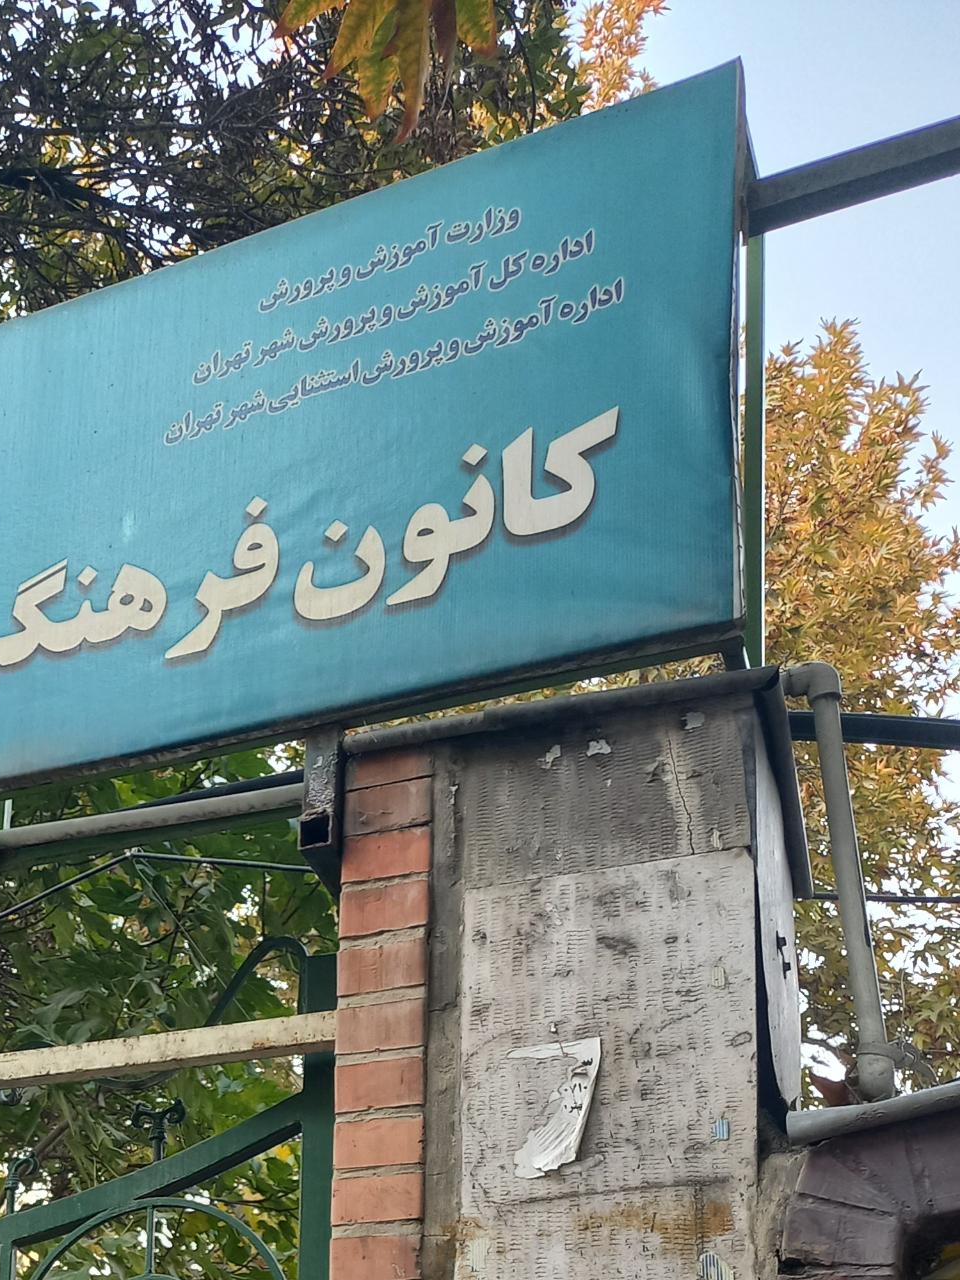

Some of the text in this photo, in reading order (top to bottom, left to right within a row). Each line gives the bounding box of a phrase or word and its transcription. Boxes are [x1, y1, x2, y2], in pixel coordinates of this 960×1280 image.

[193, 230, 595, 385] اداره کل آموزش و پرورش شهر تهران
[259, 207, 520, 312] وزارت آموزش و پرورش
[164, 278, 623, 445] اداره آموزش و پرورش استثنایی شهر تهران
[294, 406, 619, 621] کانون
